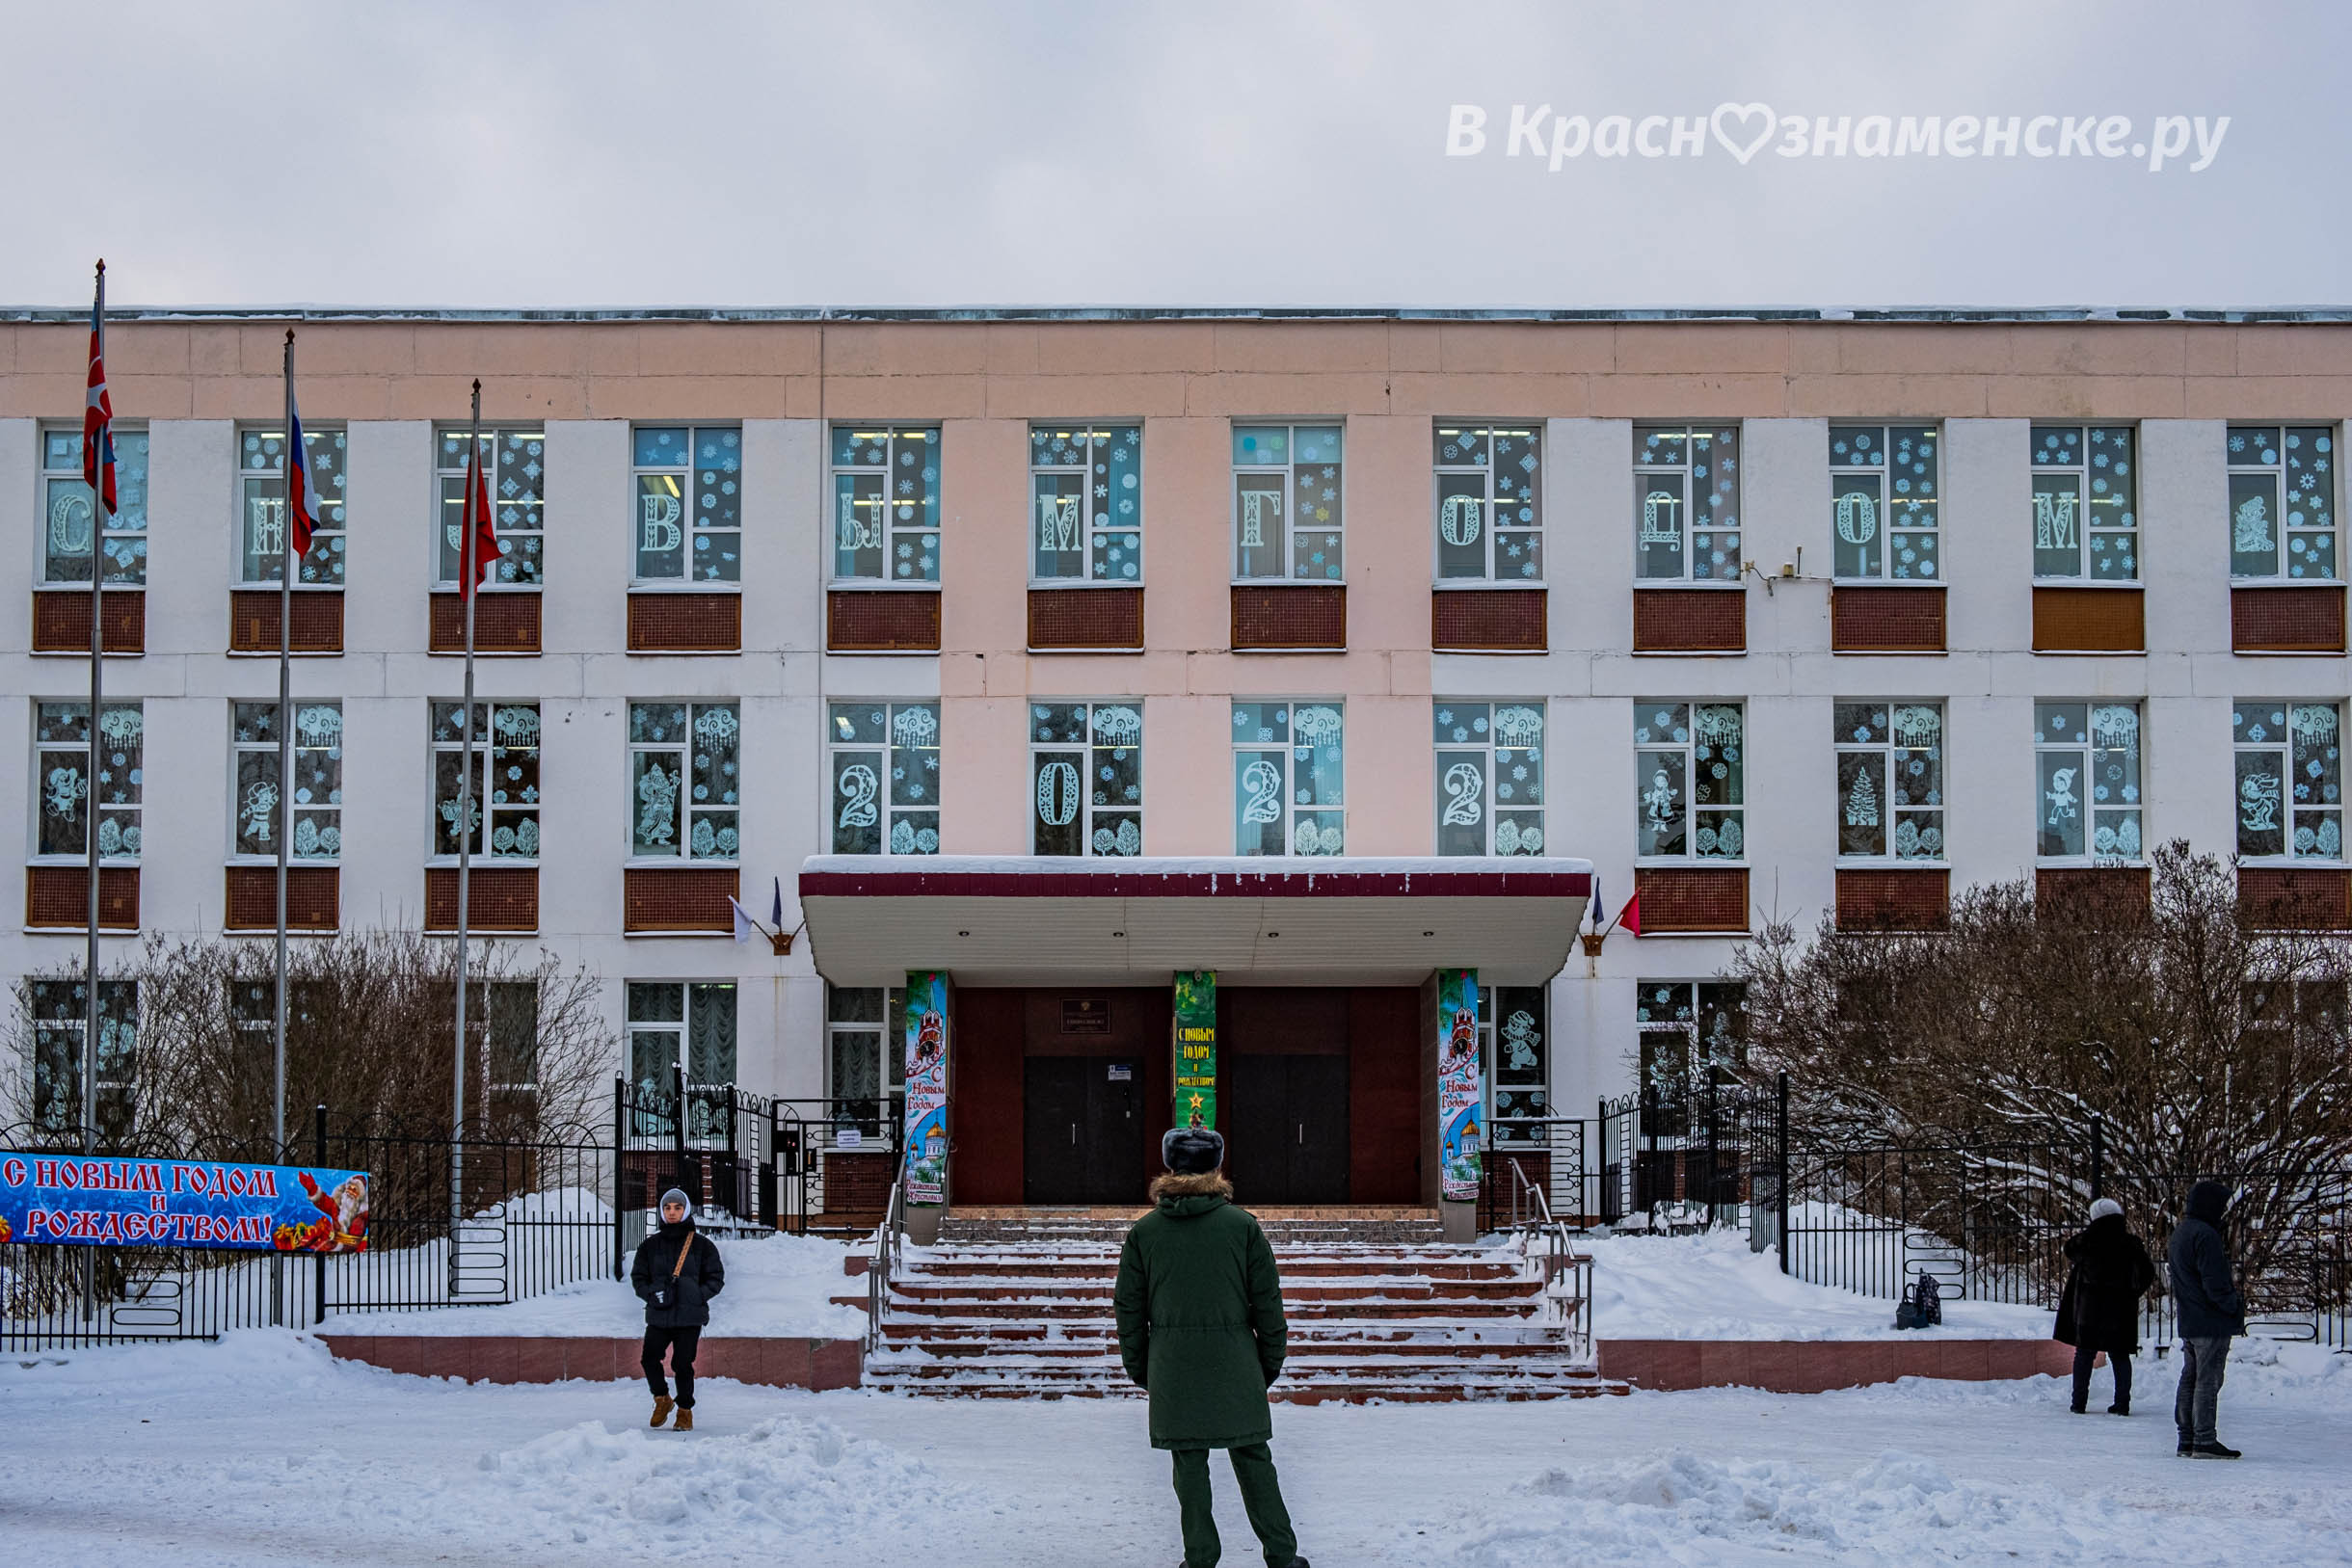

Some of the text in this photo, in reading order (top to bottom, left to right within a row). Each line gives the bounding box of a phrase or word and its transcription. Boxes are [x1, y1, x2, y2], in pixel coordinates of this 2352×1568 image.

[1185, 1027, 1215, 1042] НОВЫМ
[1183, 1045, 1210, 1060] ГОДОМ
[931, 1066, 942, 1082] С
[1465, 1063, 1475, 1080] С
[912, 1081, 945, 1095] Новым
[1445, 1079, 1478, 1093] Новым
[907, 1095, 935, 1110] Годом
[1441, 1093, 1469, 1108] Годом
[3, 1157, 280, 1202] С НОВЫМ ГОДОМ
[24, 1209, 273, 1244] РОЖДЕСТВОМ!
